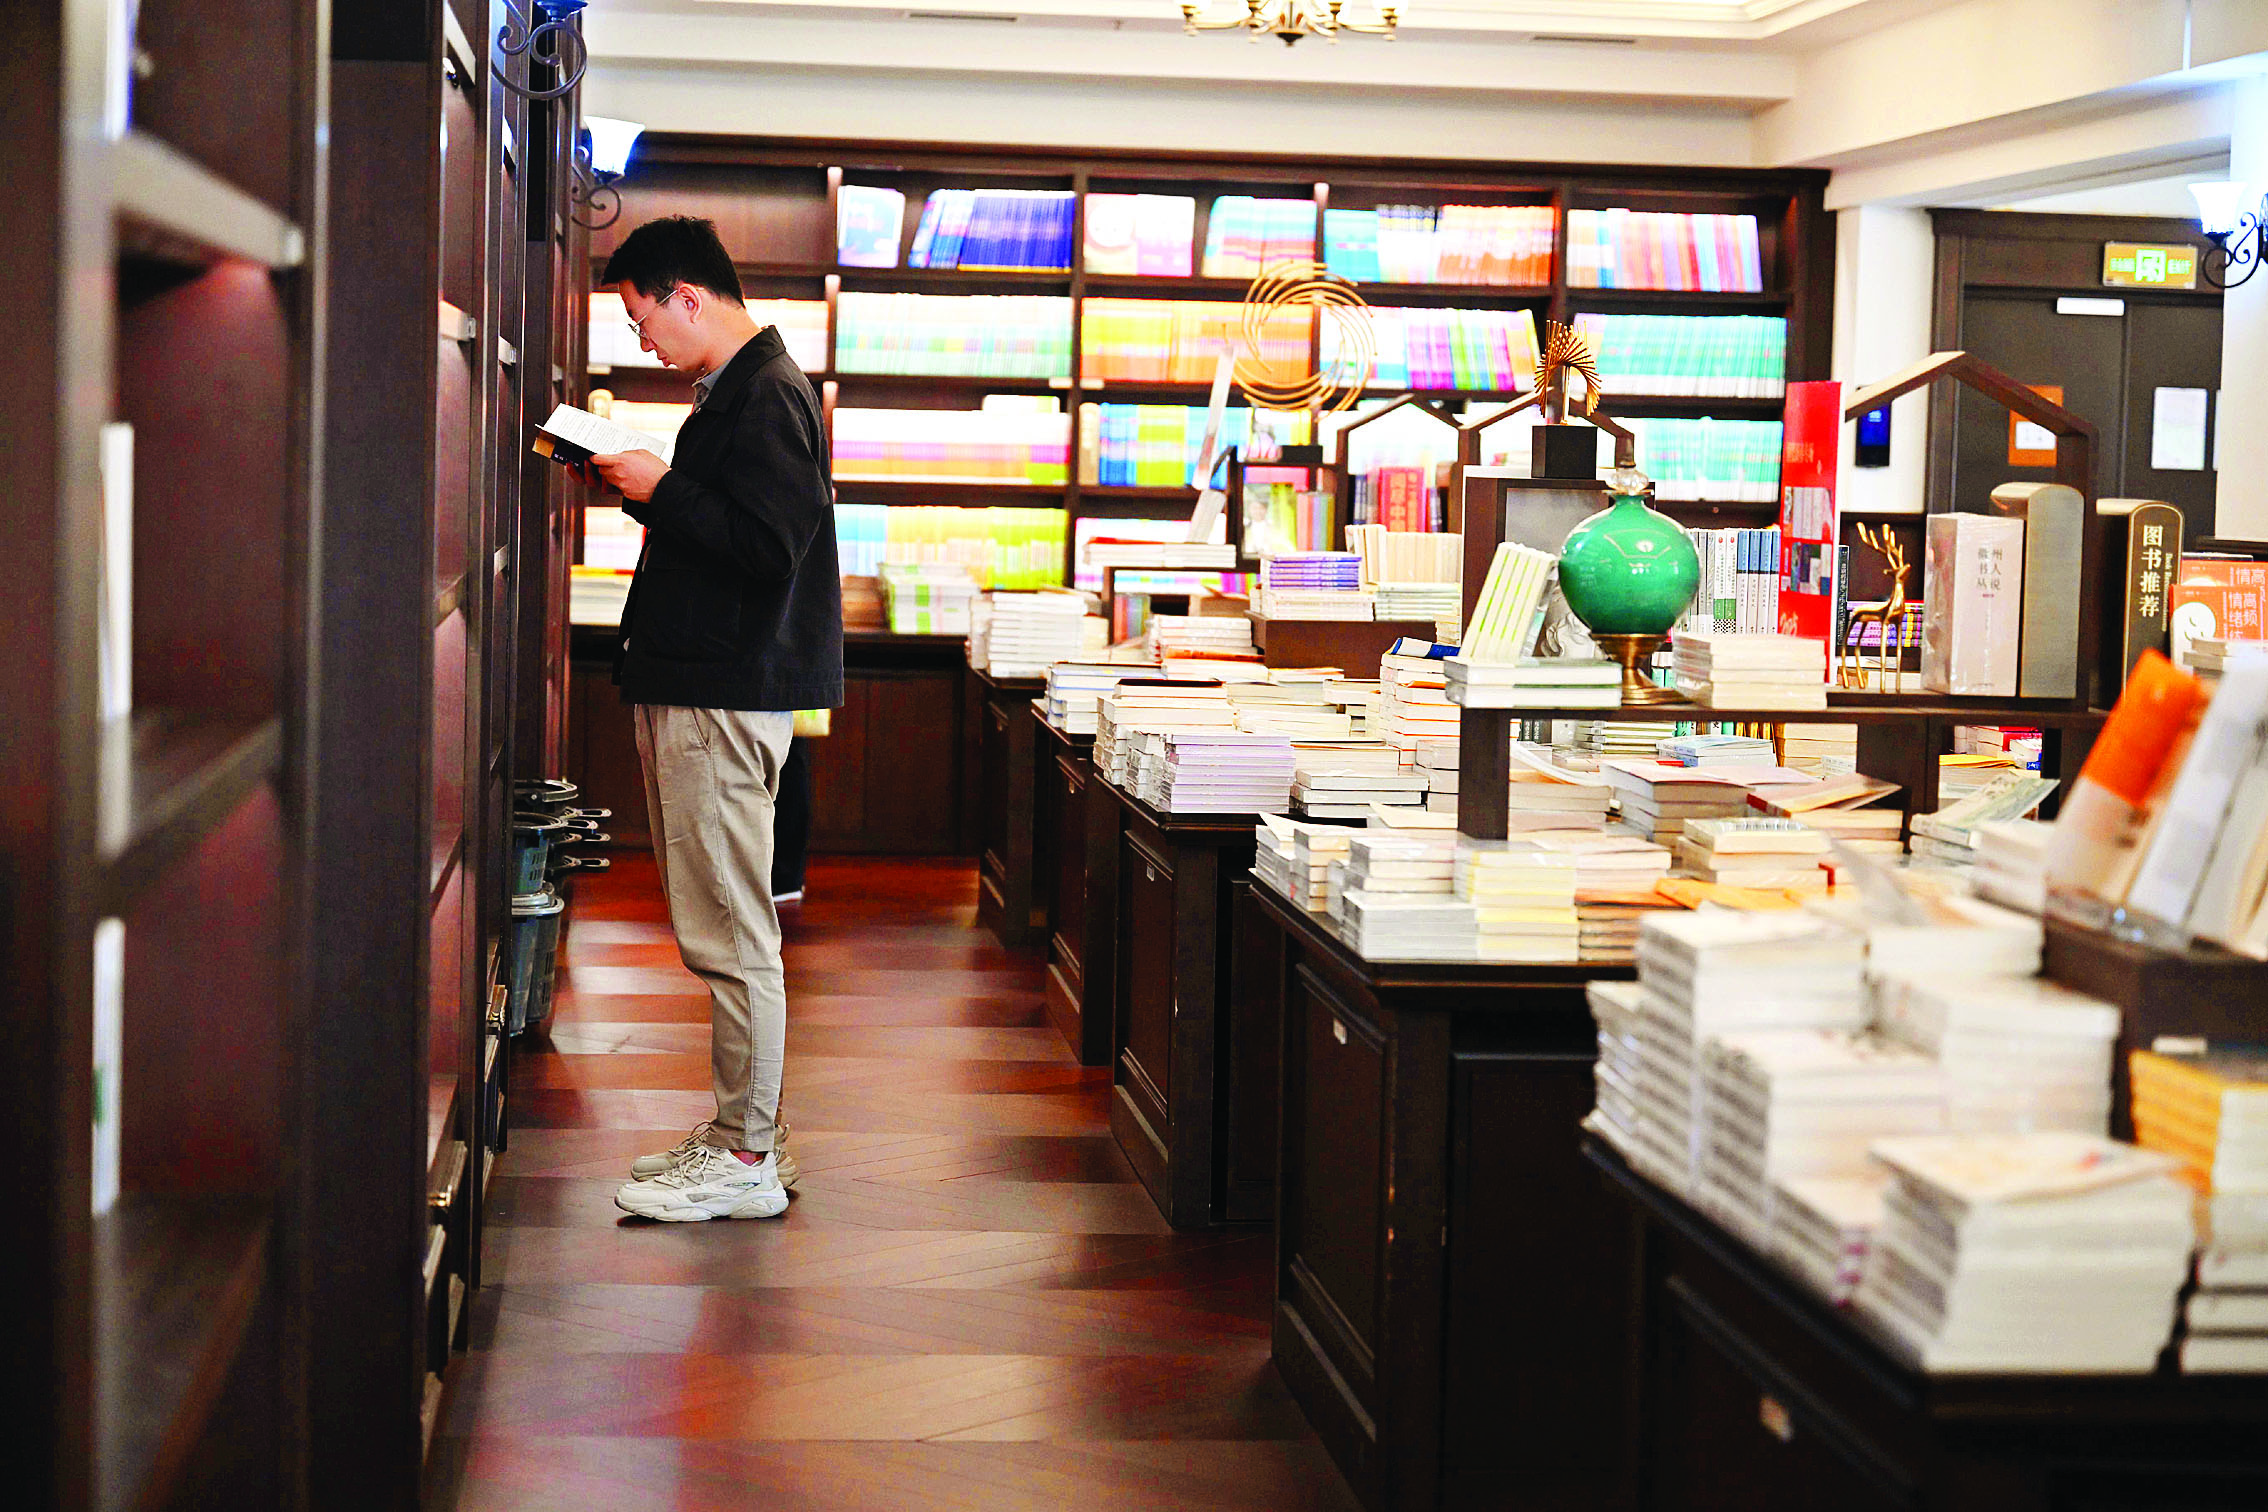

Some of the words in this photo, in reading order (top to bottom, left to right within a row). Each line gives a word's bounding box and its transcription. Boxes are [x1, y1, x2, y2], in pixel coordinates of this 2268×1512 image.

[2139, 525, 2163, 618] 图书推荐
[2243, 592, 2259, 627] 高频
